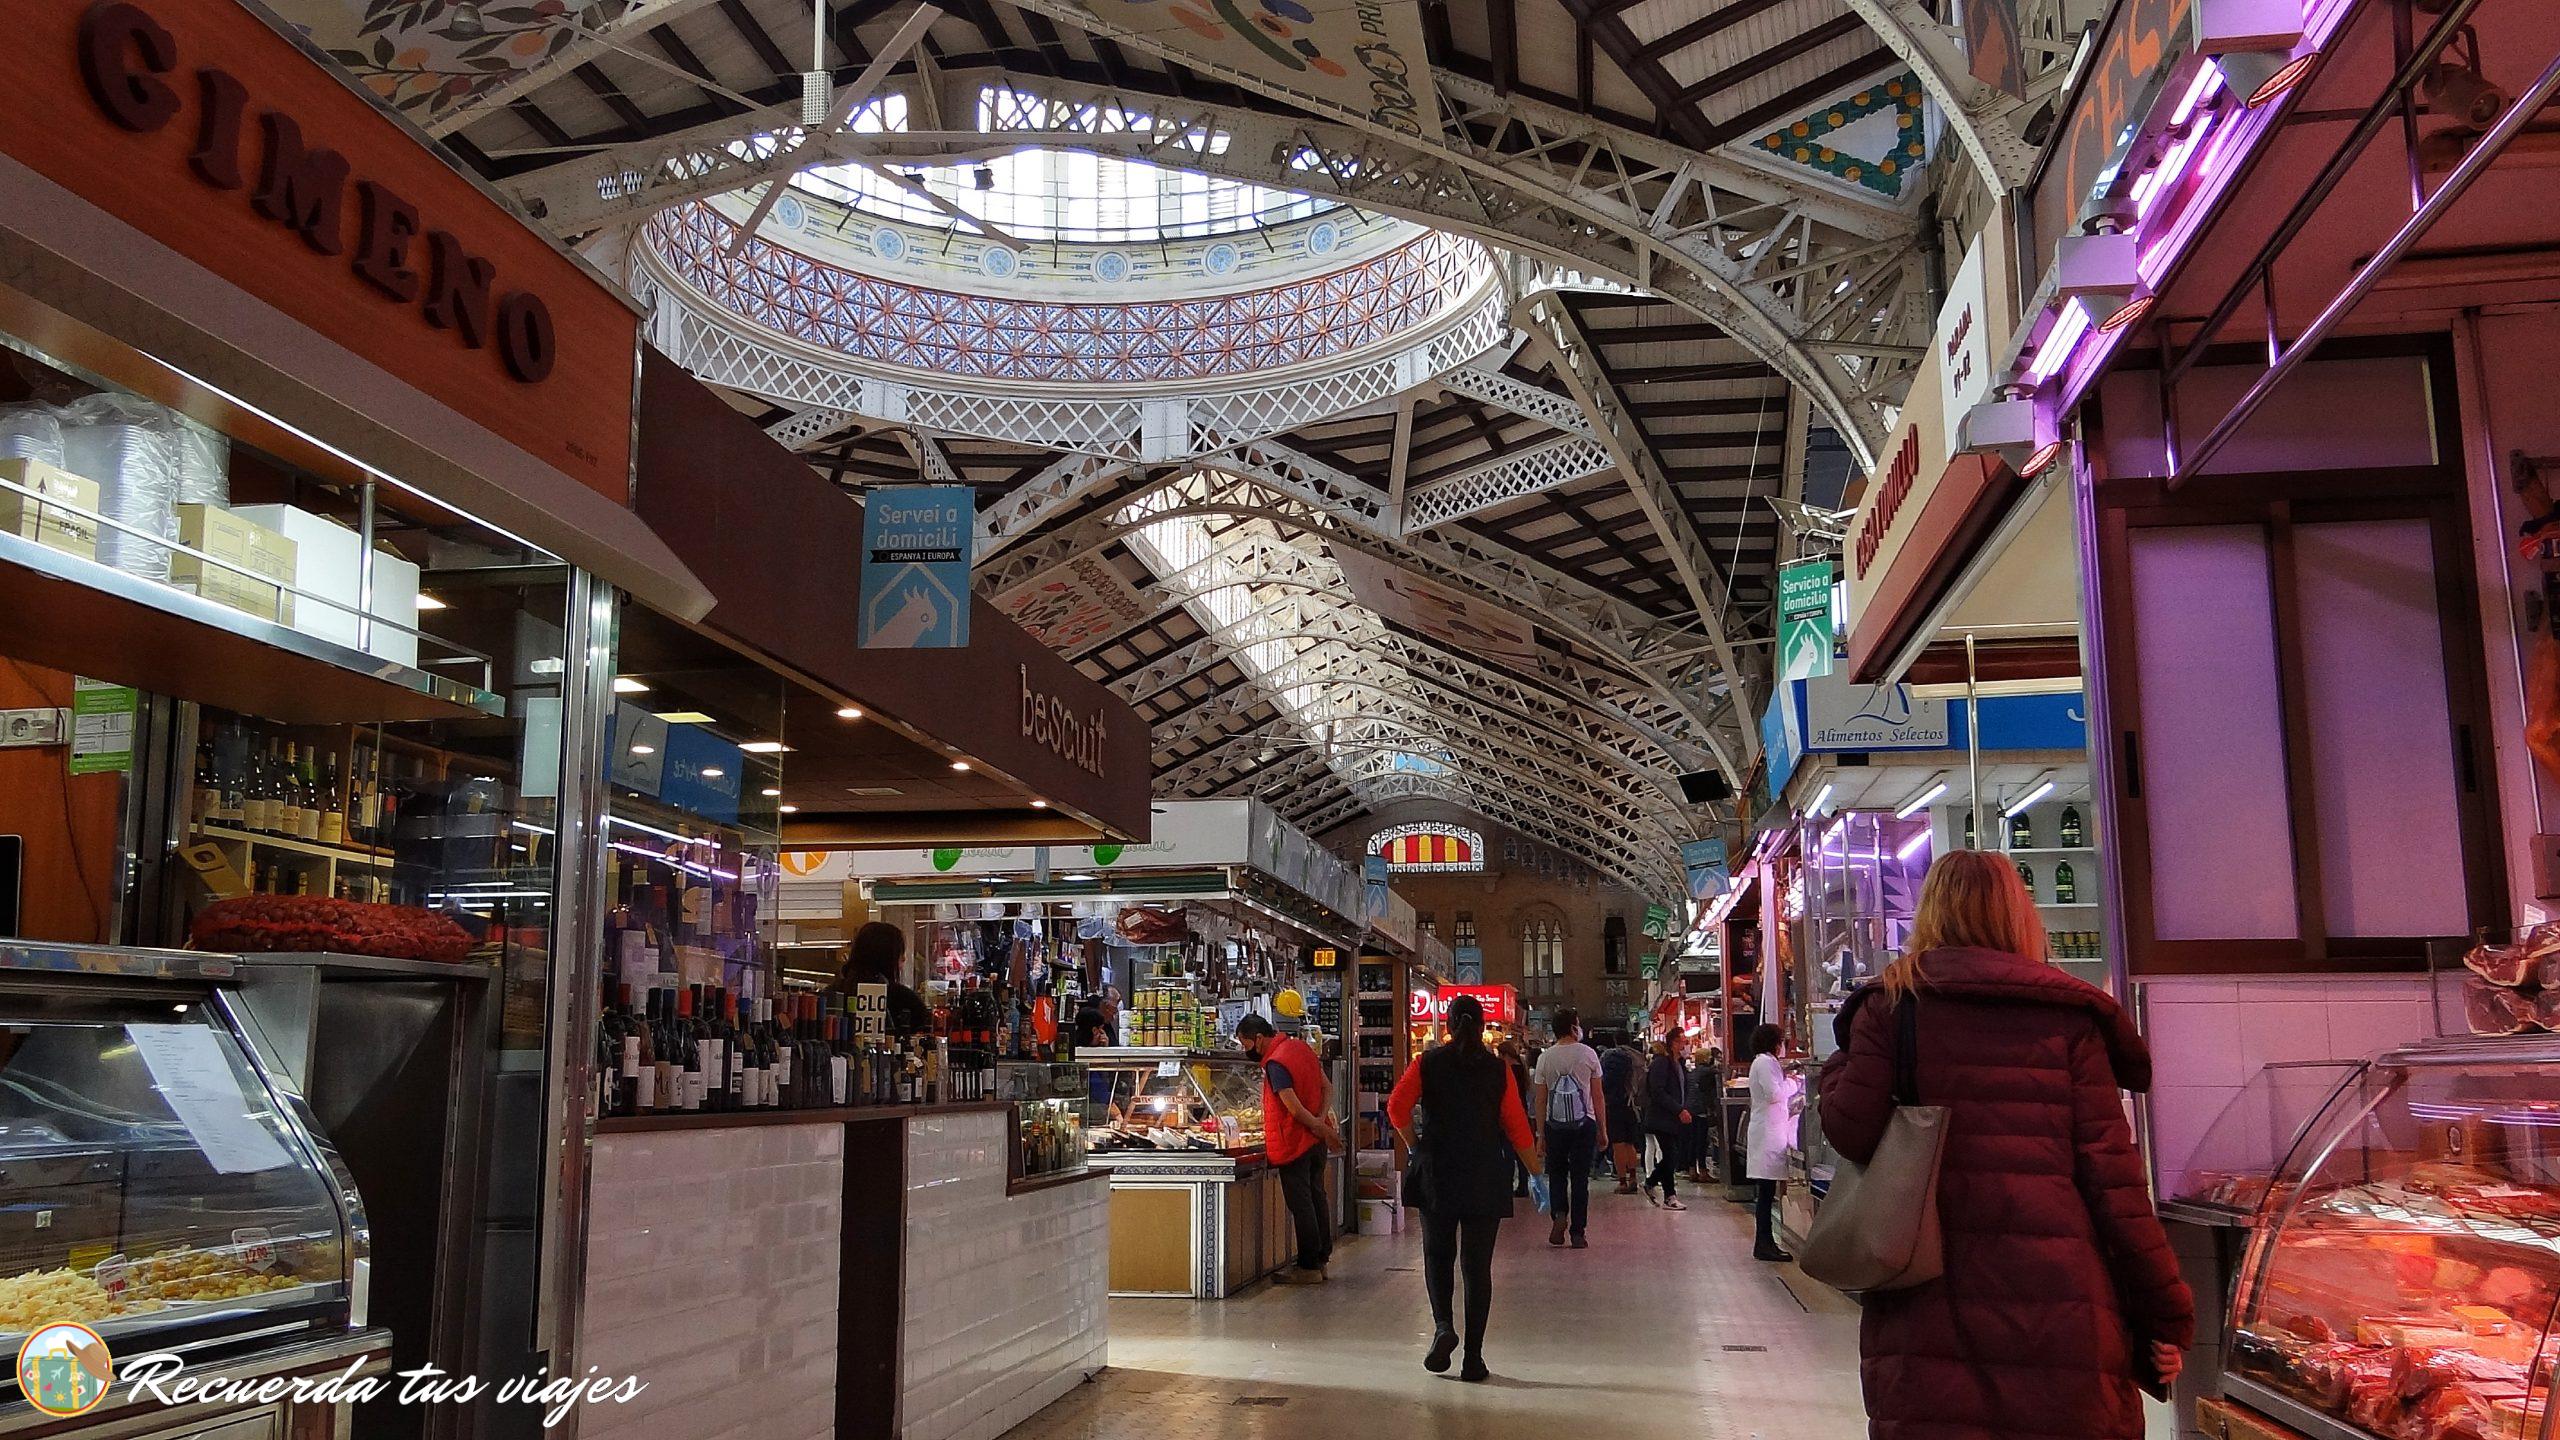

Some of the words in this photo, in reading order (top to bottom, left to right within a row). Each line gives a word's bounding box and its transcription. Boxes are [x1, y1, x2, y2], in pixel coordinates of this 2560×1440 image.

[78, 2, 556, 382] GIMENO
[879, 503, 940, 524] Servei
[946, 507, 958, 523] a
[876, 527, 958, 549] domicili
[890, 552, 921, 561] ESPANYA
[928, 551, 955, 560] EUROPA
[1783, 574, 1821, 594] Servicio
[1822, 575, 1829, 586] a
[1784, 590, 1828, 611] domicilio
[1813, 729, 1883, 745] Alimentos
[1889, 726, 1944, 742] Selectos
